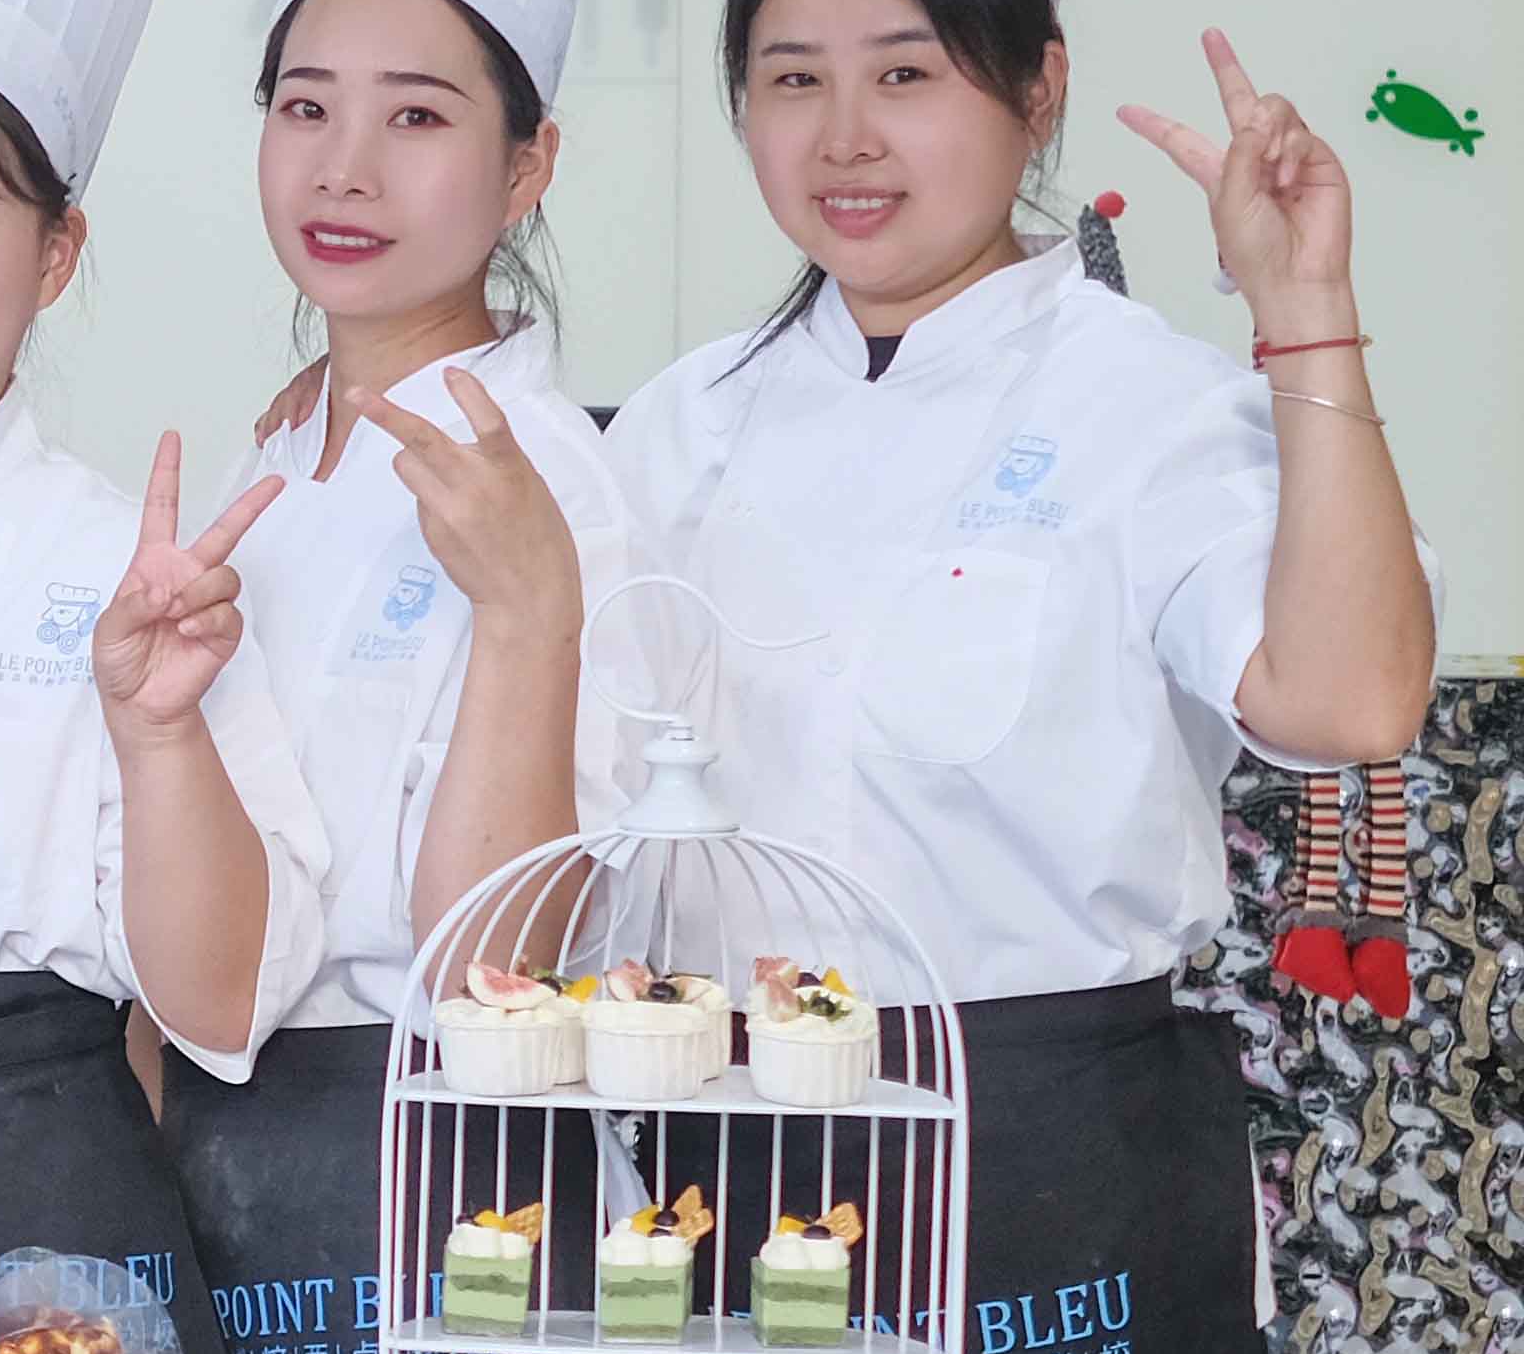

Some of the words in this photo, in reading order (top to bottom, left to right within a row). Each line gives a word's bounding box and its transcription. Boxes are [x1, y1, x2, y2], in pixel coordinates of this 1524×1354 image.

[23, 654, 76, 677] POINT
[59, 1253, 175, 1310] BLEU
[212, 1278, 334, 1339] POINT
